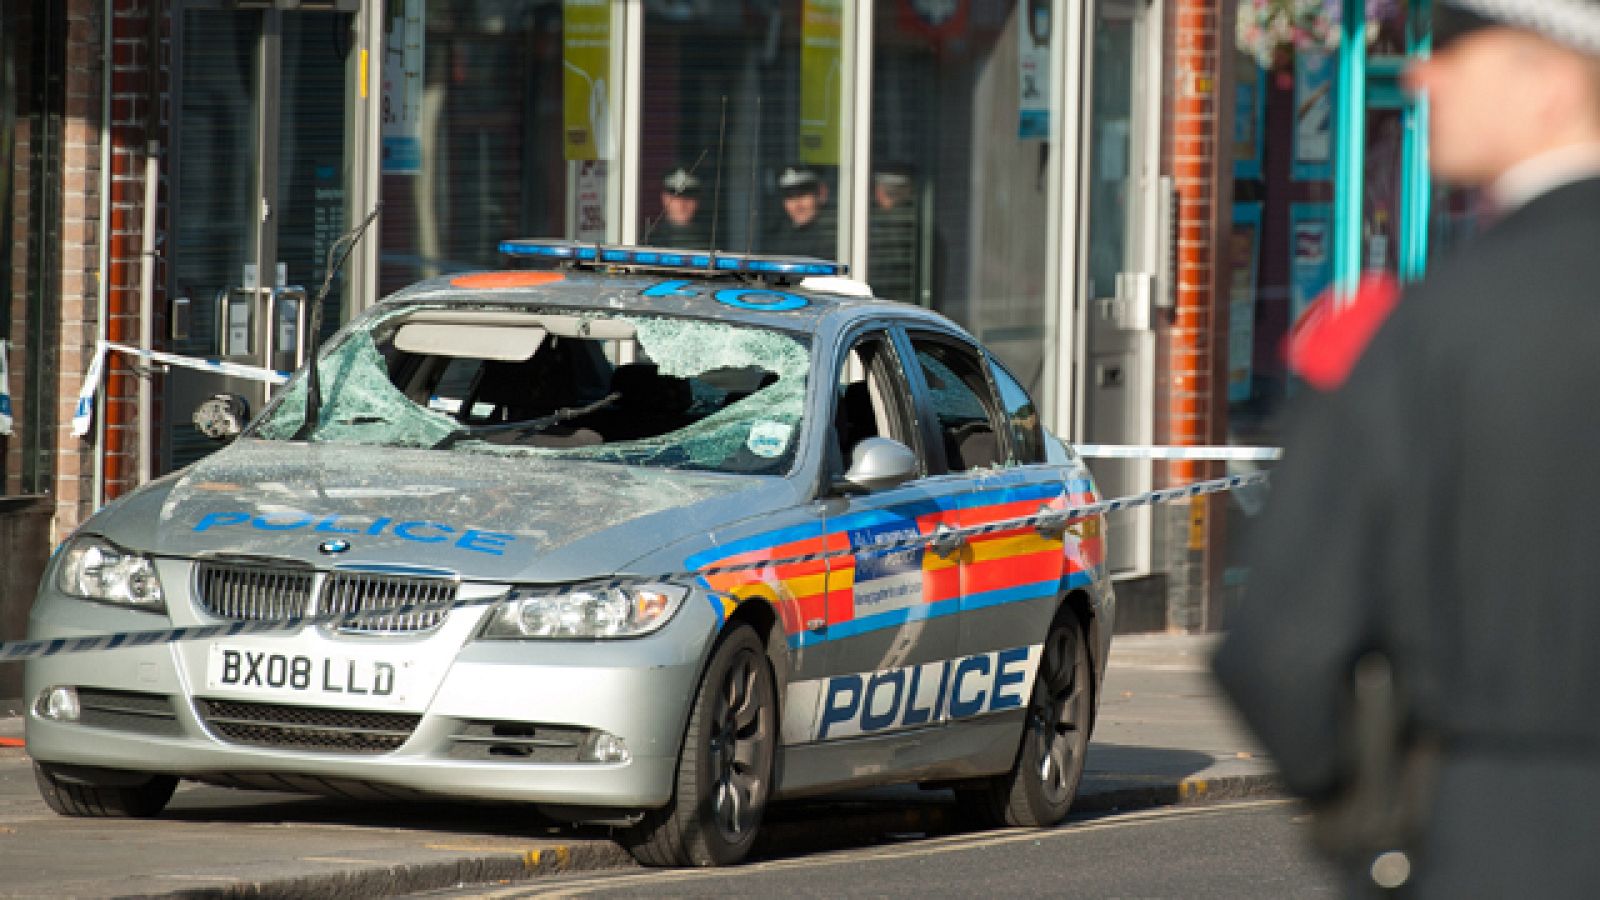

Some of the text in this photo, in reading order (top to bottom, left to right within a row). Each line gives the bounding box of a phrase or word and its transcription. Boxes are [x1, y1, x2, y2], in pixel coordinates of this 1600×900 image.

[192, 511, 517, 556] POLICE
[221, 650, 396, 695] BX08 LLD
[817, 646, 1029, 740] POLICE
